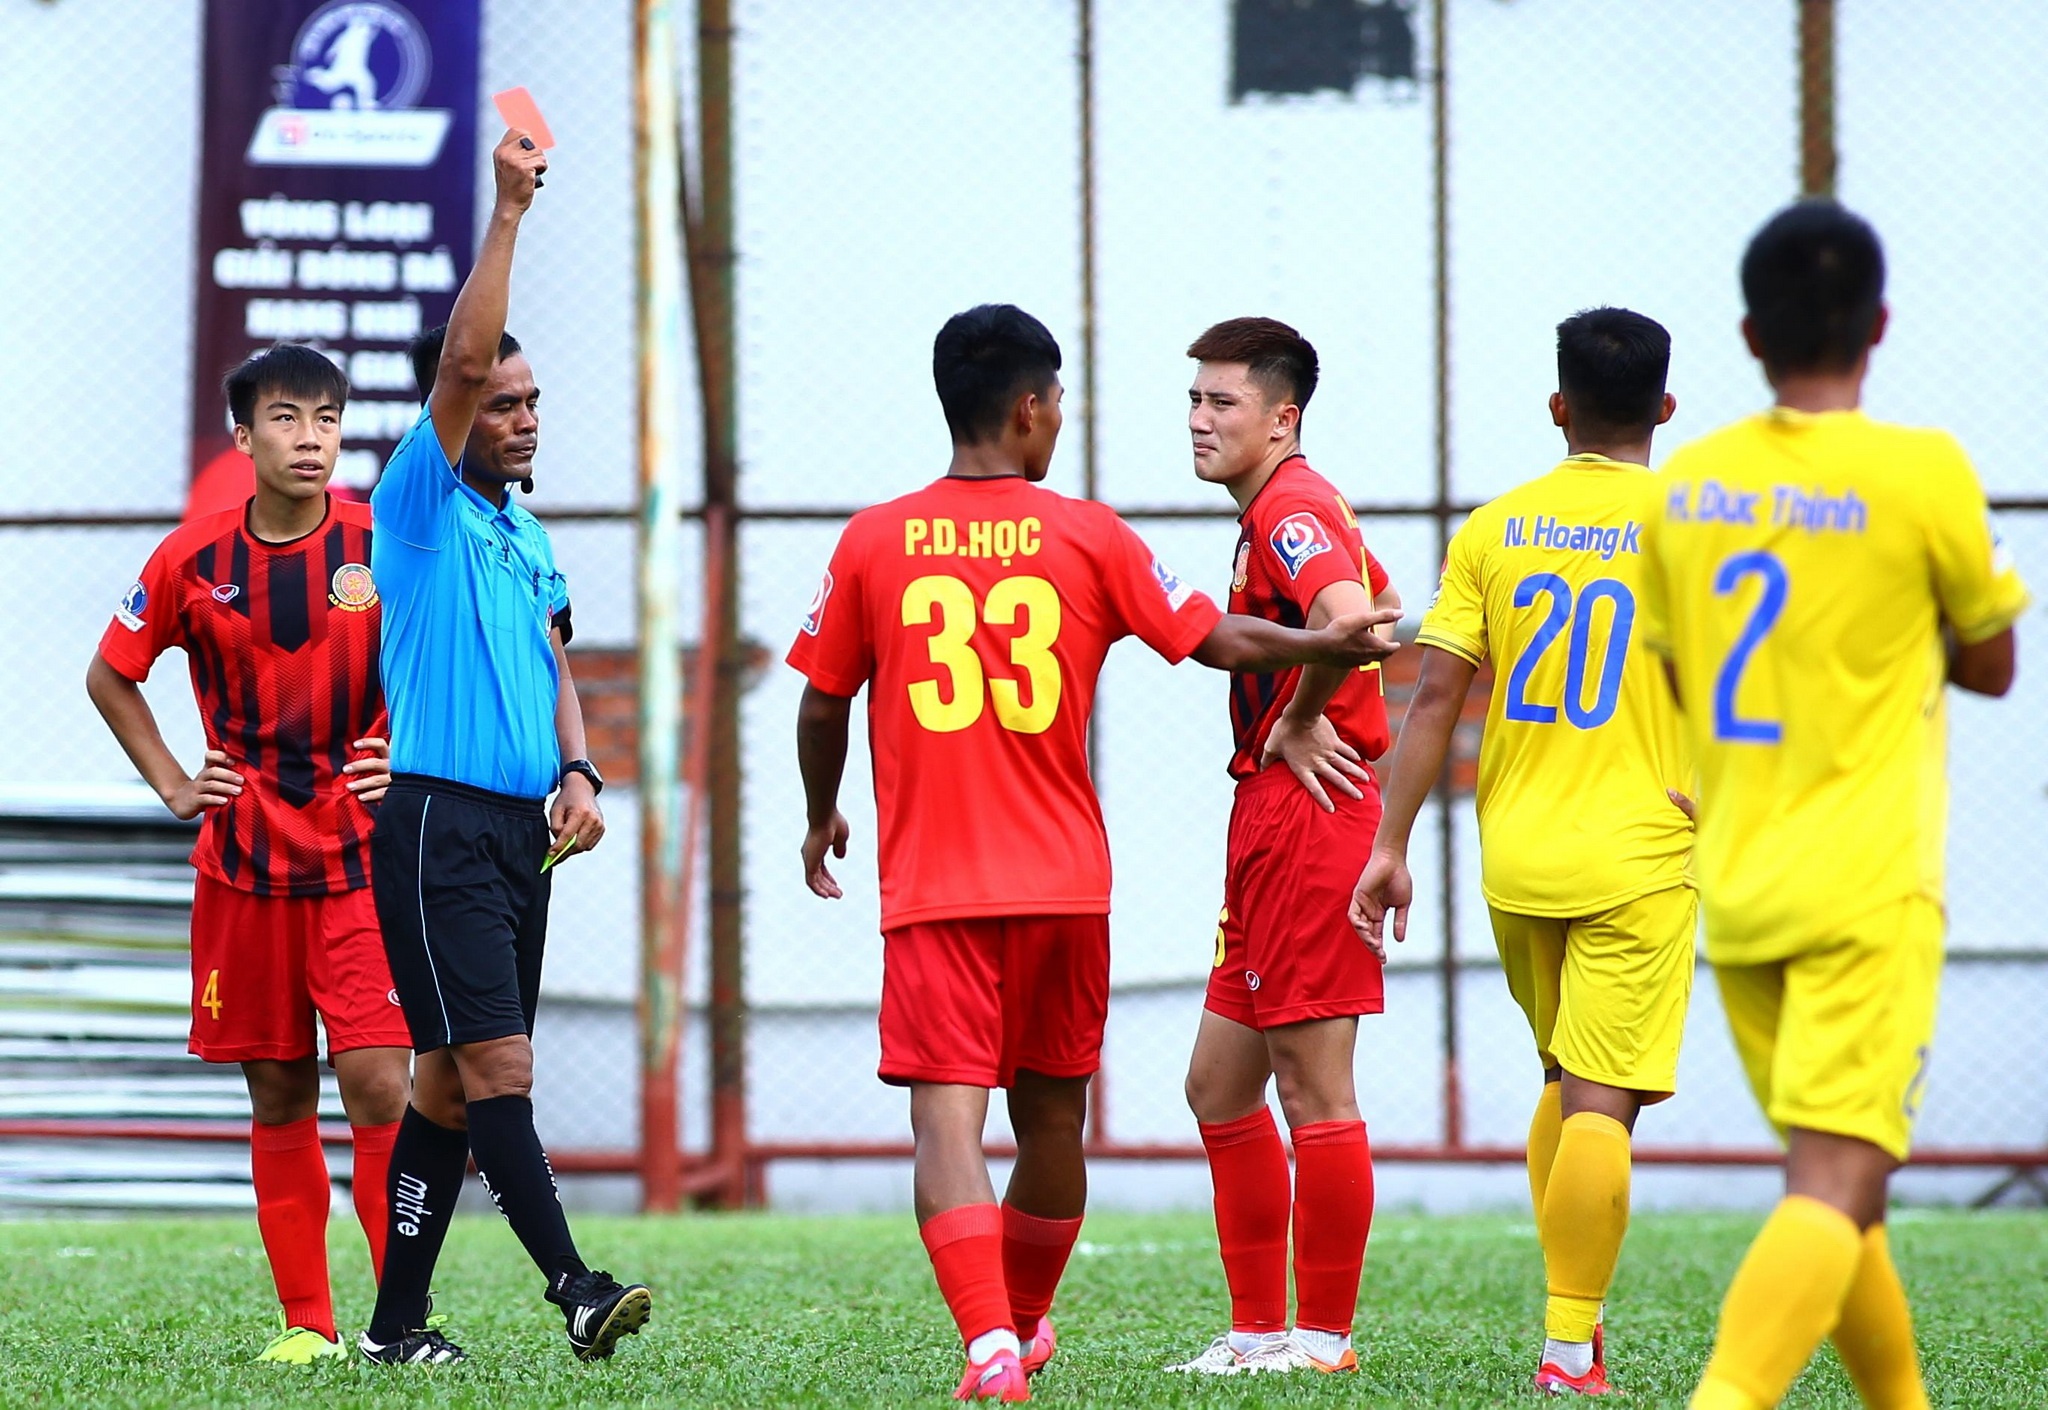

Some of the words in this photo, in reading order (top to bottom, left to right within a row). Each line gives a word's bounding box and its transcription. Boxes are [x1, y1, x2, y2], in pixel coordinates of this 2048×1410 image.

[905, 516, 1041, 568] P.D.HỌC
[1292, 542, 1324, 571] SPORTS
[901, 574, 1062, 735] 33
[1506, 572, 1636, 731] 20
[1712, 549, 1790, 743] 2
[201, 968, 224, 1021] 4
[395, 1172, 433, 1237] mitre
